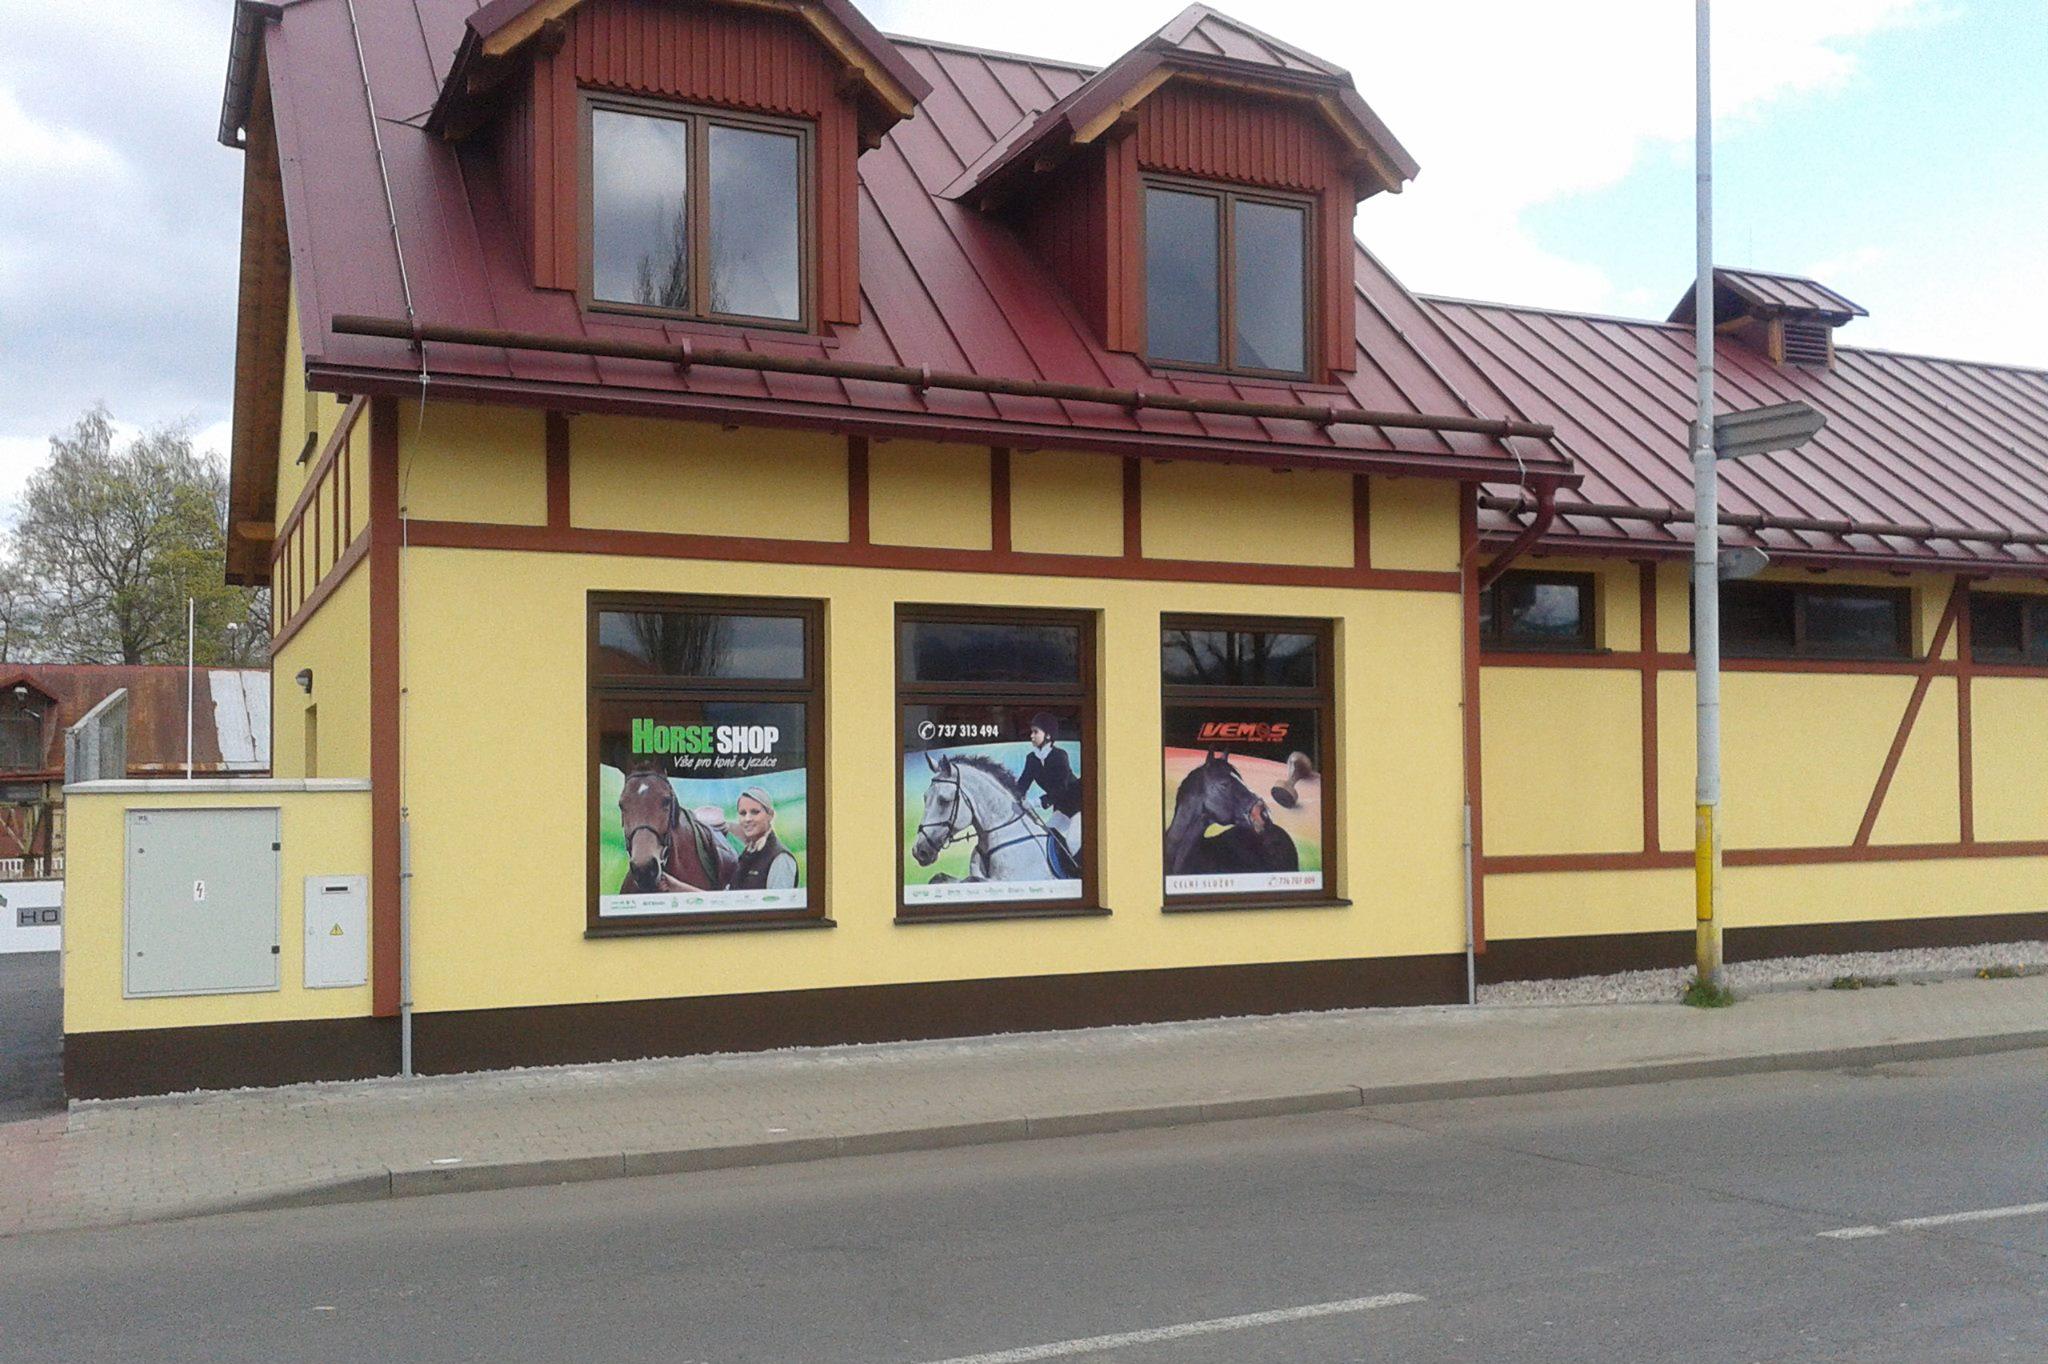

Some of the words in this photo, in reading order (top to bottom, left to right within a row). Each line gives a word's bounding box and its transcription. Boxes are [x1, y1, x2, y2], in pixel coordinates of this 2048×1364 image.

[937, 724, 957, 737] 737
[959, 724, 978, 737] 313
[979, 724, 999, 737] 494
[716, 725, 779, 754] SHOP
[694, 758, 712, 770] pro
